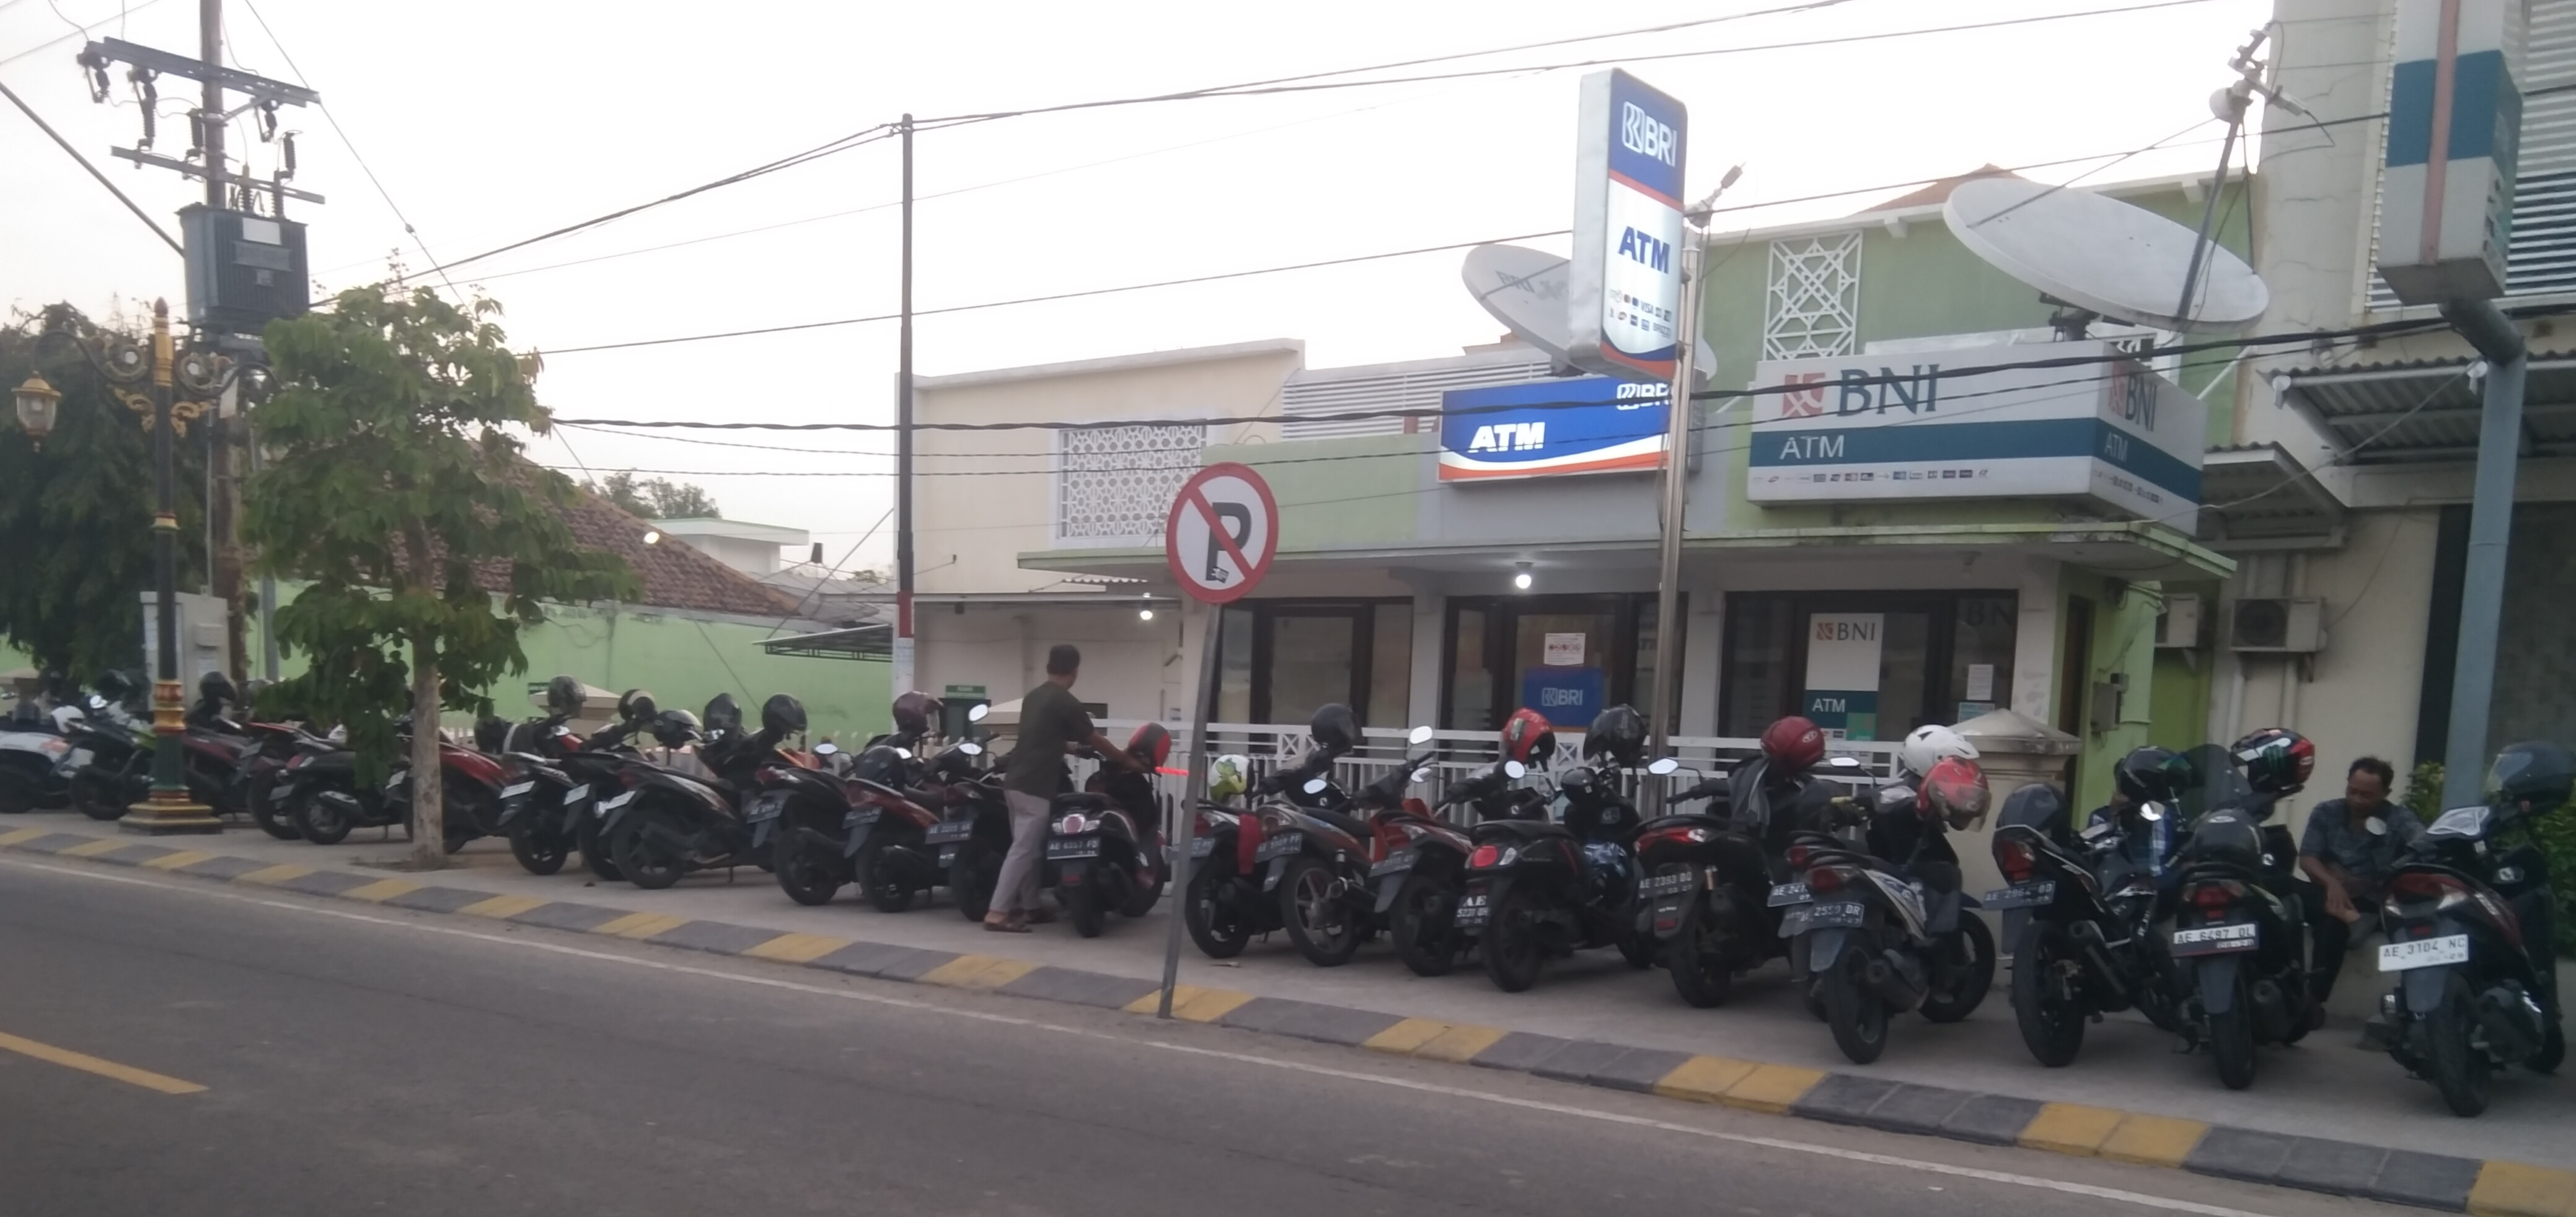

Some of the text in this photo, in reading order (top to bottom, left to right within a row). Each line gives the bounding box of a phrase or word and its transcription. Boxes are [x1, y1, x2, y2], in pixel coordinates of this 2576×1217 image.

[1644, 116, 1677, 167] BRI
[1618, 226, 1670, 275] ATM
[1641, 383, 1673, 406] BR
[1837, 363, 1939, 417] BNI
[2125, 369, 2157, 433] BNI
[1467, 422, 1545, 453] ATM
[1779, 435, 1845, 459] ATM
[2105, 432, 2128, 463] ATM
[1205, 502, 1252, 581] P
[1837, 622, 1876, 641] BNI
[1558, 689, 1583, 705] BRI
[1812, 698, 1846, 713] ATM
[1639, 878, 1650, 889] AE
[1772, 886, 1786, 896] AE
[1463, 895, 1487, 907] AE
[1985, 892, 1998, 901] AE
[1846, 904, 1860, 915] DR
[2177, 933, 2192, 943] AE
[2200, 929, 2230, 940] 6497
[2384, 938, 2466, 957] AE 3104 NC
